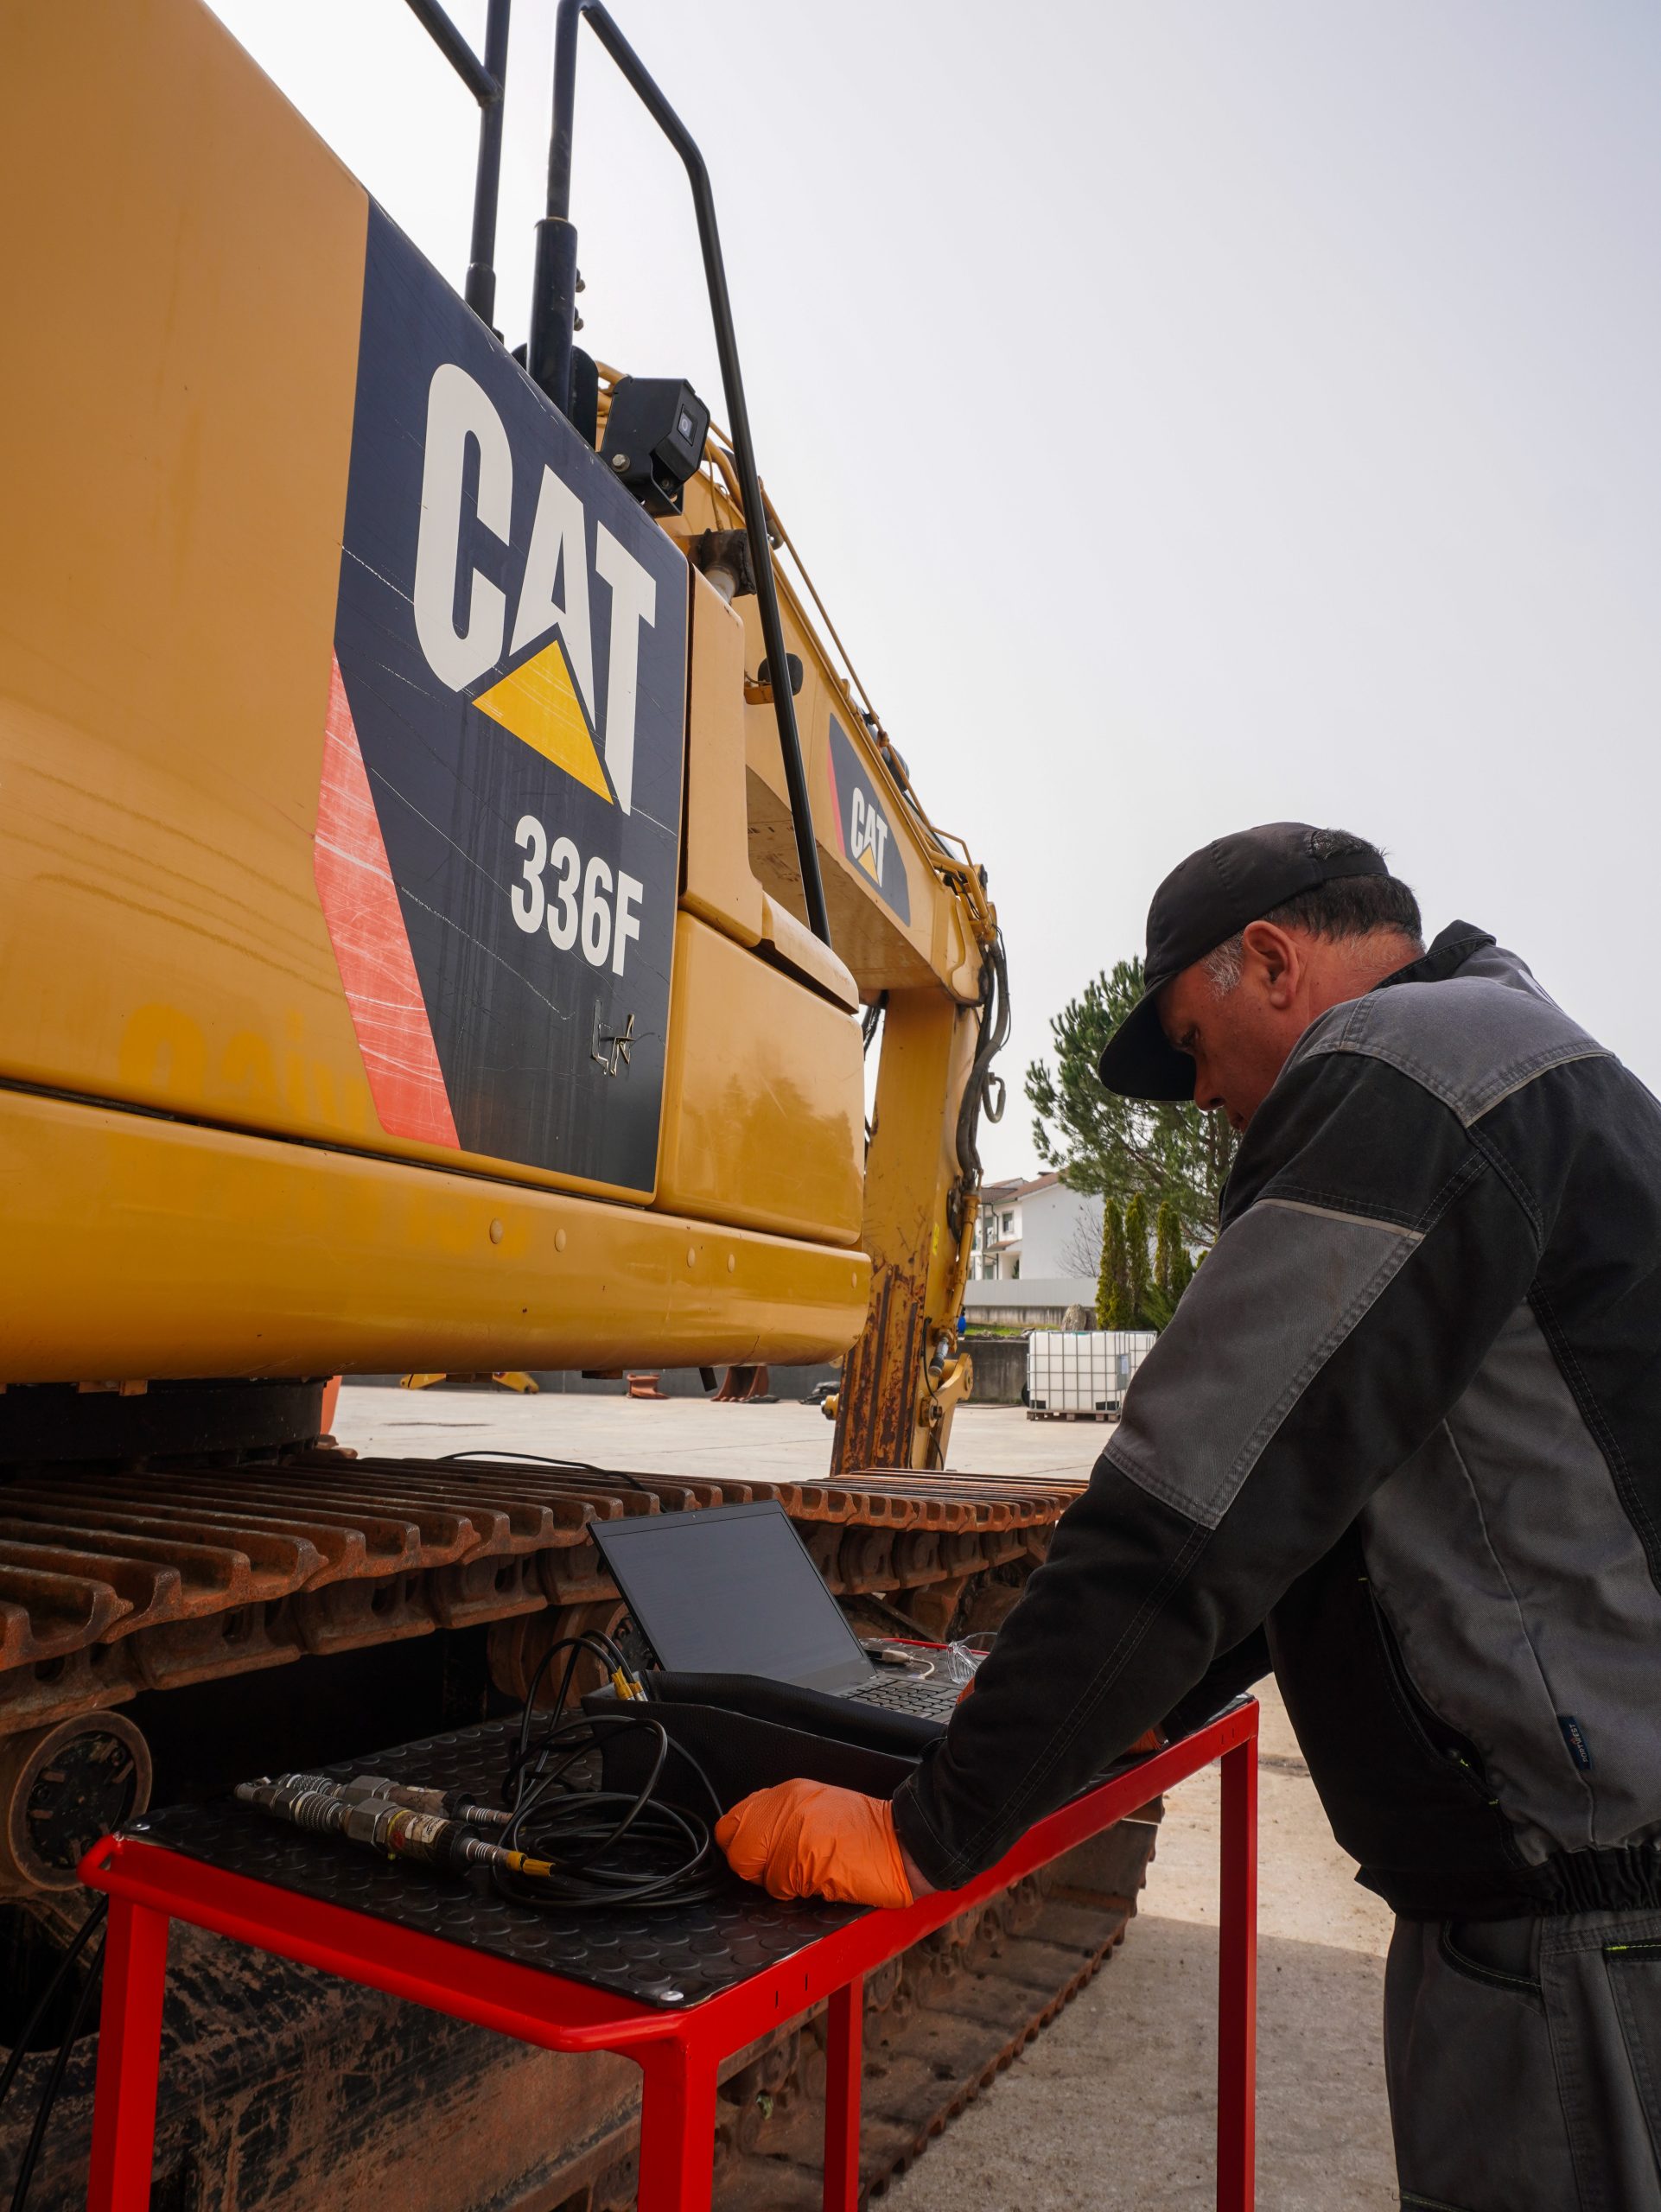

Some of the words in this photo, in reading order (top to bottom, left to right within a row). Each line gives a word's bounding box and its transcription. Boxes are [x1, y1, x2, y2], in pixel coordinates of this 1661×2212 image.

[414, 364, 656, 816] CAT
[511, 815, 644, 976] 336F
[851, 787, 888, 888] CAT
[1569, 1724, 1588, 1763] PORTWEST
